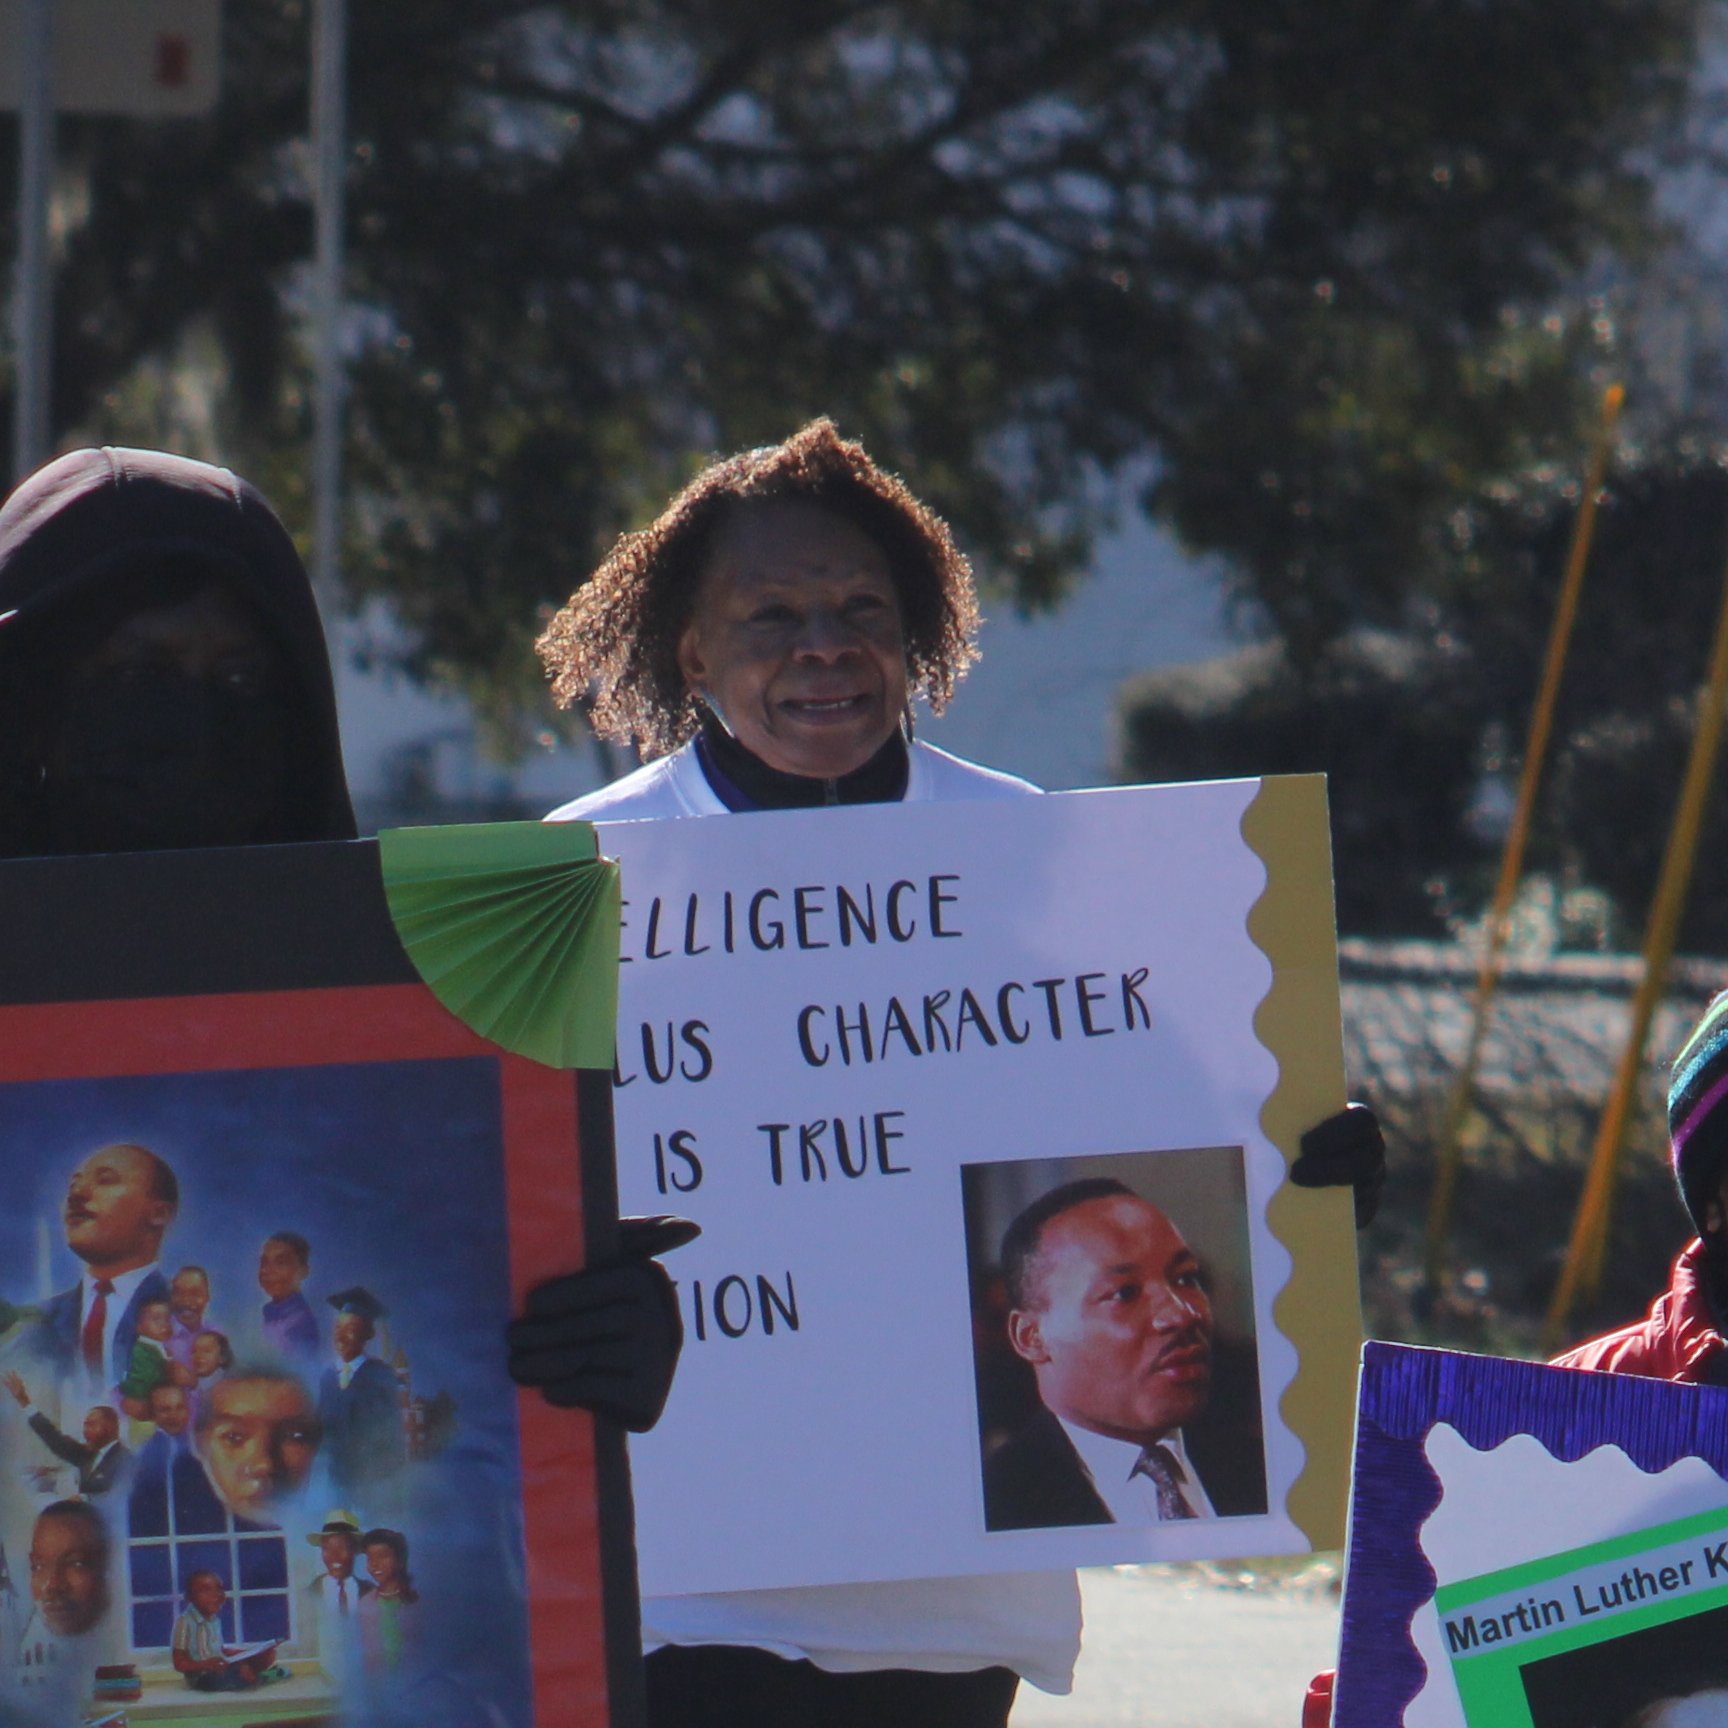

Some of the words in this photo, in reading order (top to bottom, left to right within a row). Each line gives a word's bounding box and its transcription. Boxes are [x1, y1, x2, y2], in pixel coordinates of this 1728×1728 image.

[796, 967, 1151, 1067] CHARACTER
[653, 1129, 704, 1195] IS
[756, 1110, 912, 1186] TRUE
[670, 1270, 800, 1342] ION
[1444, 1597, 1566, 1654] Martin
[1572, 1559, 1694, 1617] Luther
